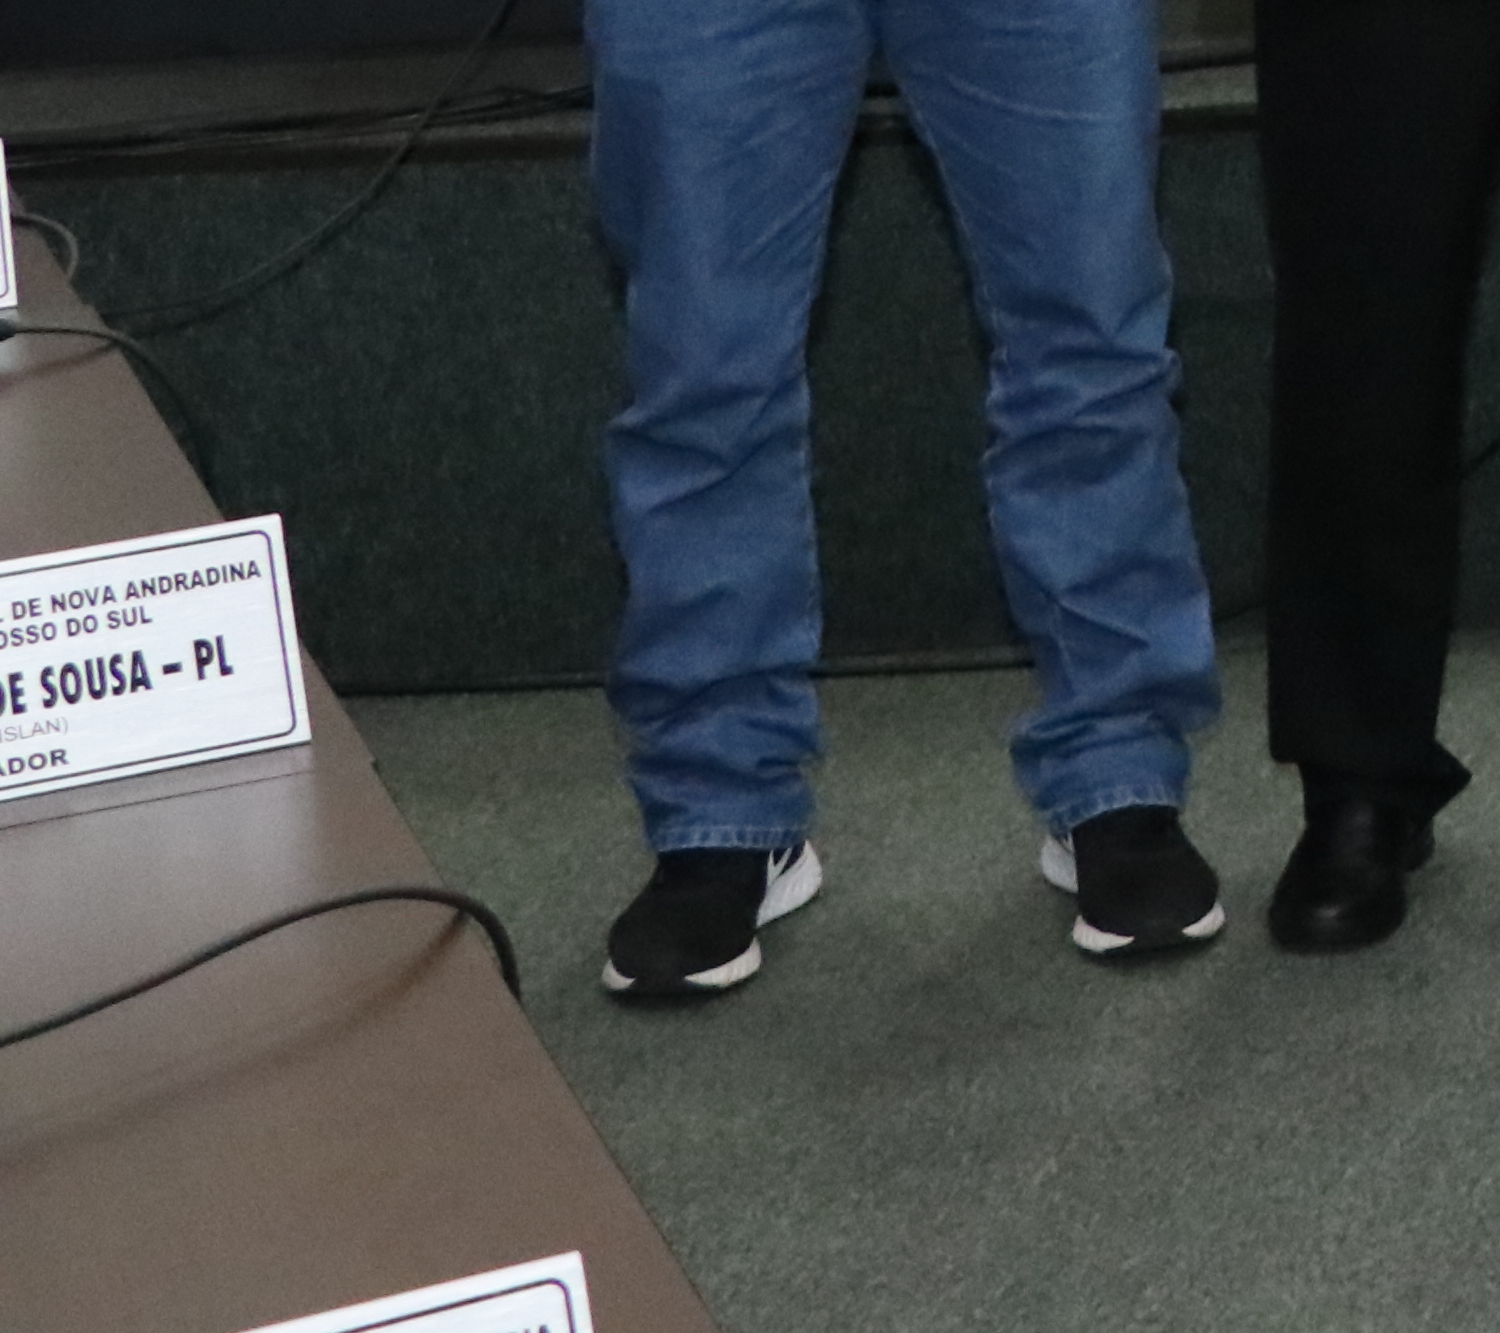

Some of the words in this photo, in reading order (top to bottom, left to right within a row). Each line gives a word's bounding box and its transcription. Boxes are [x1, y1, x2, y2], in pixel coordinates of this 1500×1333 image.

[12, 597, 43, 621] DE
[50, 584, 118, 615] NOVA
[125, 559, 263, 602] ANDRADINA
[66, 614, 99, 638] DO
[107, 605, 154, 631] SUL
[40, 648, 154, 710] SOUSA
[193, 634, 235, 681] PL
